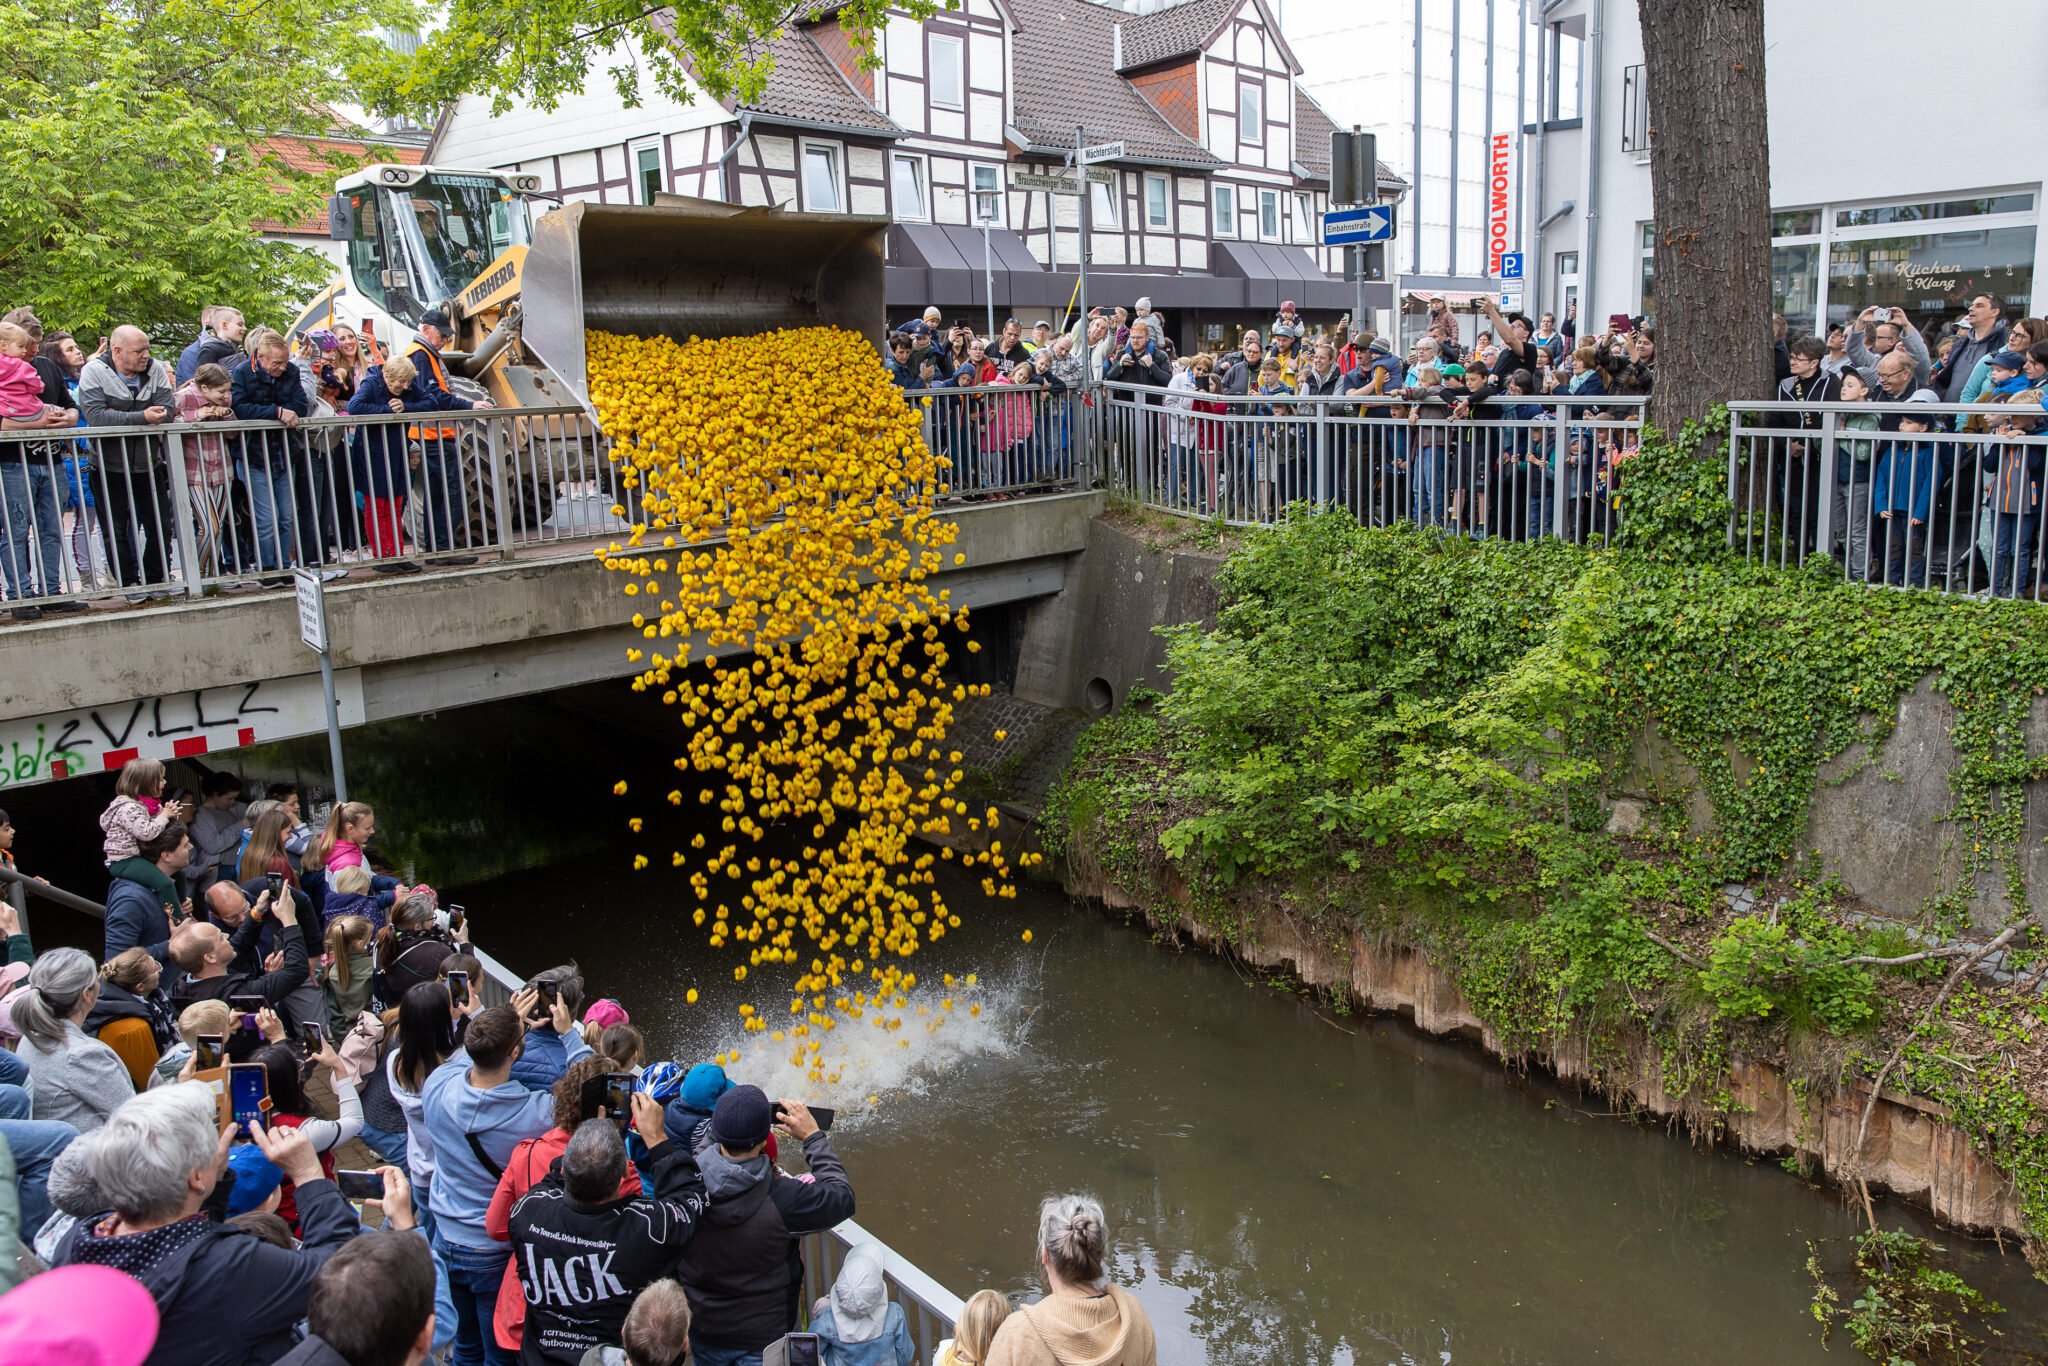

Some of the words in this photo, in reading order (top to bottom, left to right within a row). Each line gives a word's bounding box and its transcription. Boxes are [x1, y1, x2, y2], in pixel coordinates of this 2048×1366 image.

[1085, 145, 1121, 159] Wächterstieg
[430, 175, 496, 189] LIEBHERR
[1490, 134, 1509, 274] WOOLWORTH
[1327, 221, 1371, 233] Einbahnstraße
[1504, 256, 1517, 276] P
[1895, 261, 1961, 277] Küchen
[466, 260, 516, 309] LIEBHERR
[1915, 277, 1956, 291] Klang
[529, 1223, 541, 1234] Pace
[561, 1233, 576, 1244] Drink
